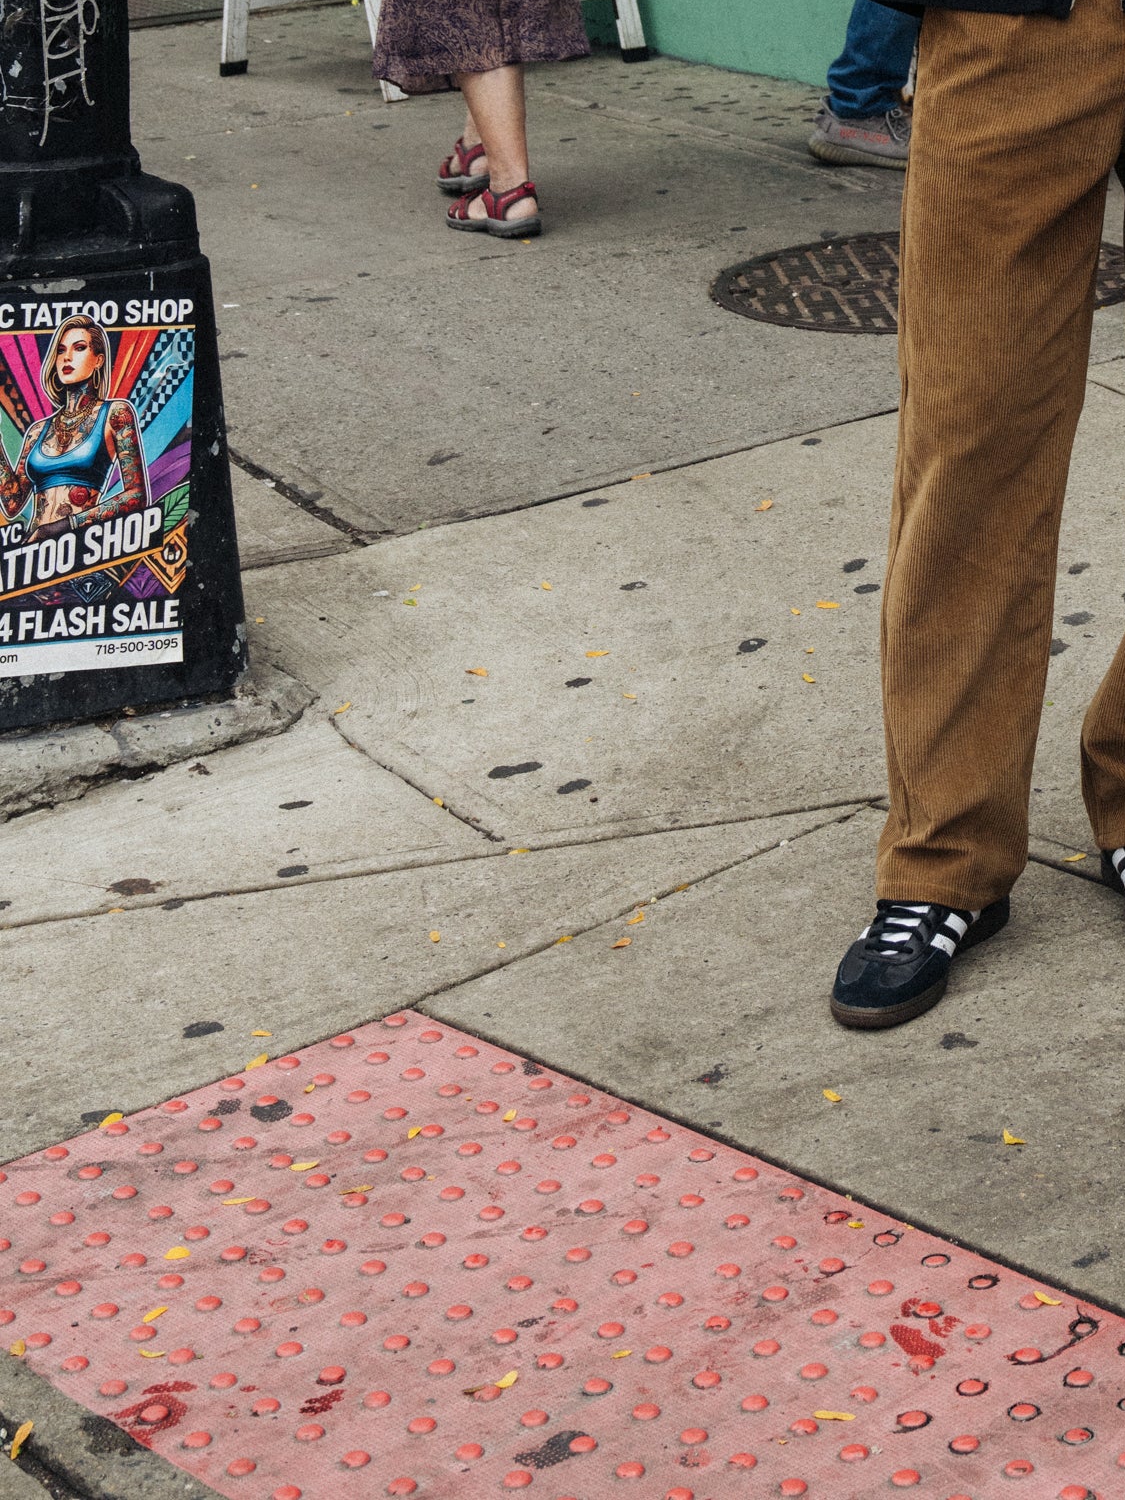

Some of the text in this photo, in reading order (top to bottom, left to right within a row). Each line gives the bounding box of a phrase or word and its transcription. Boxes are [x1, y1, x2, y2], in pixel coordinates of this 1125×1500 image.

[125, 298, 194, 324] SHOP
[0, 506, 162, 593] TTOO SHOP
[19, 607, 105, 642] FLASH
[112, 599, 180, 633] SALE
[95, 638, 179, 656] 718-500-3095
